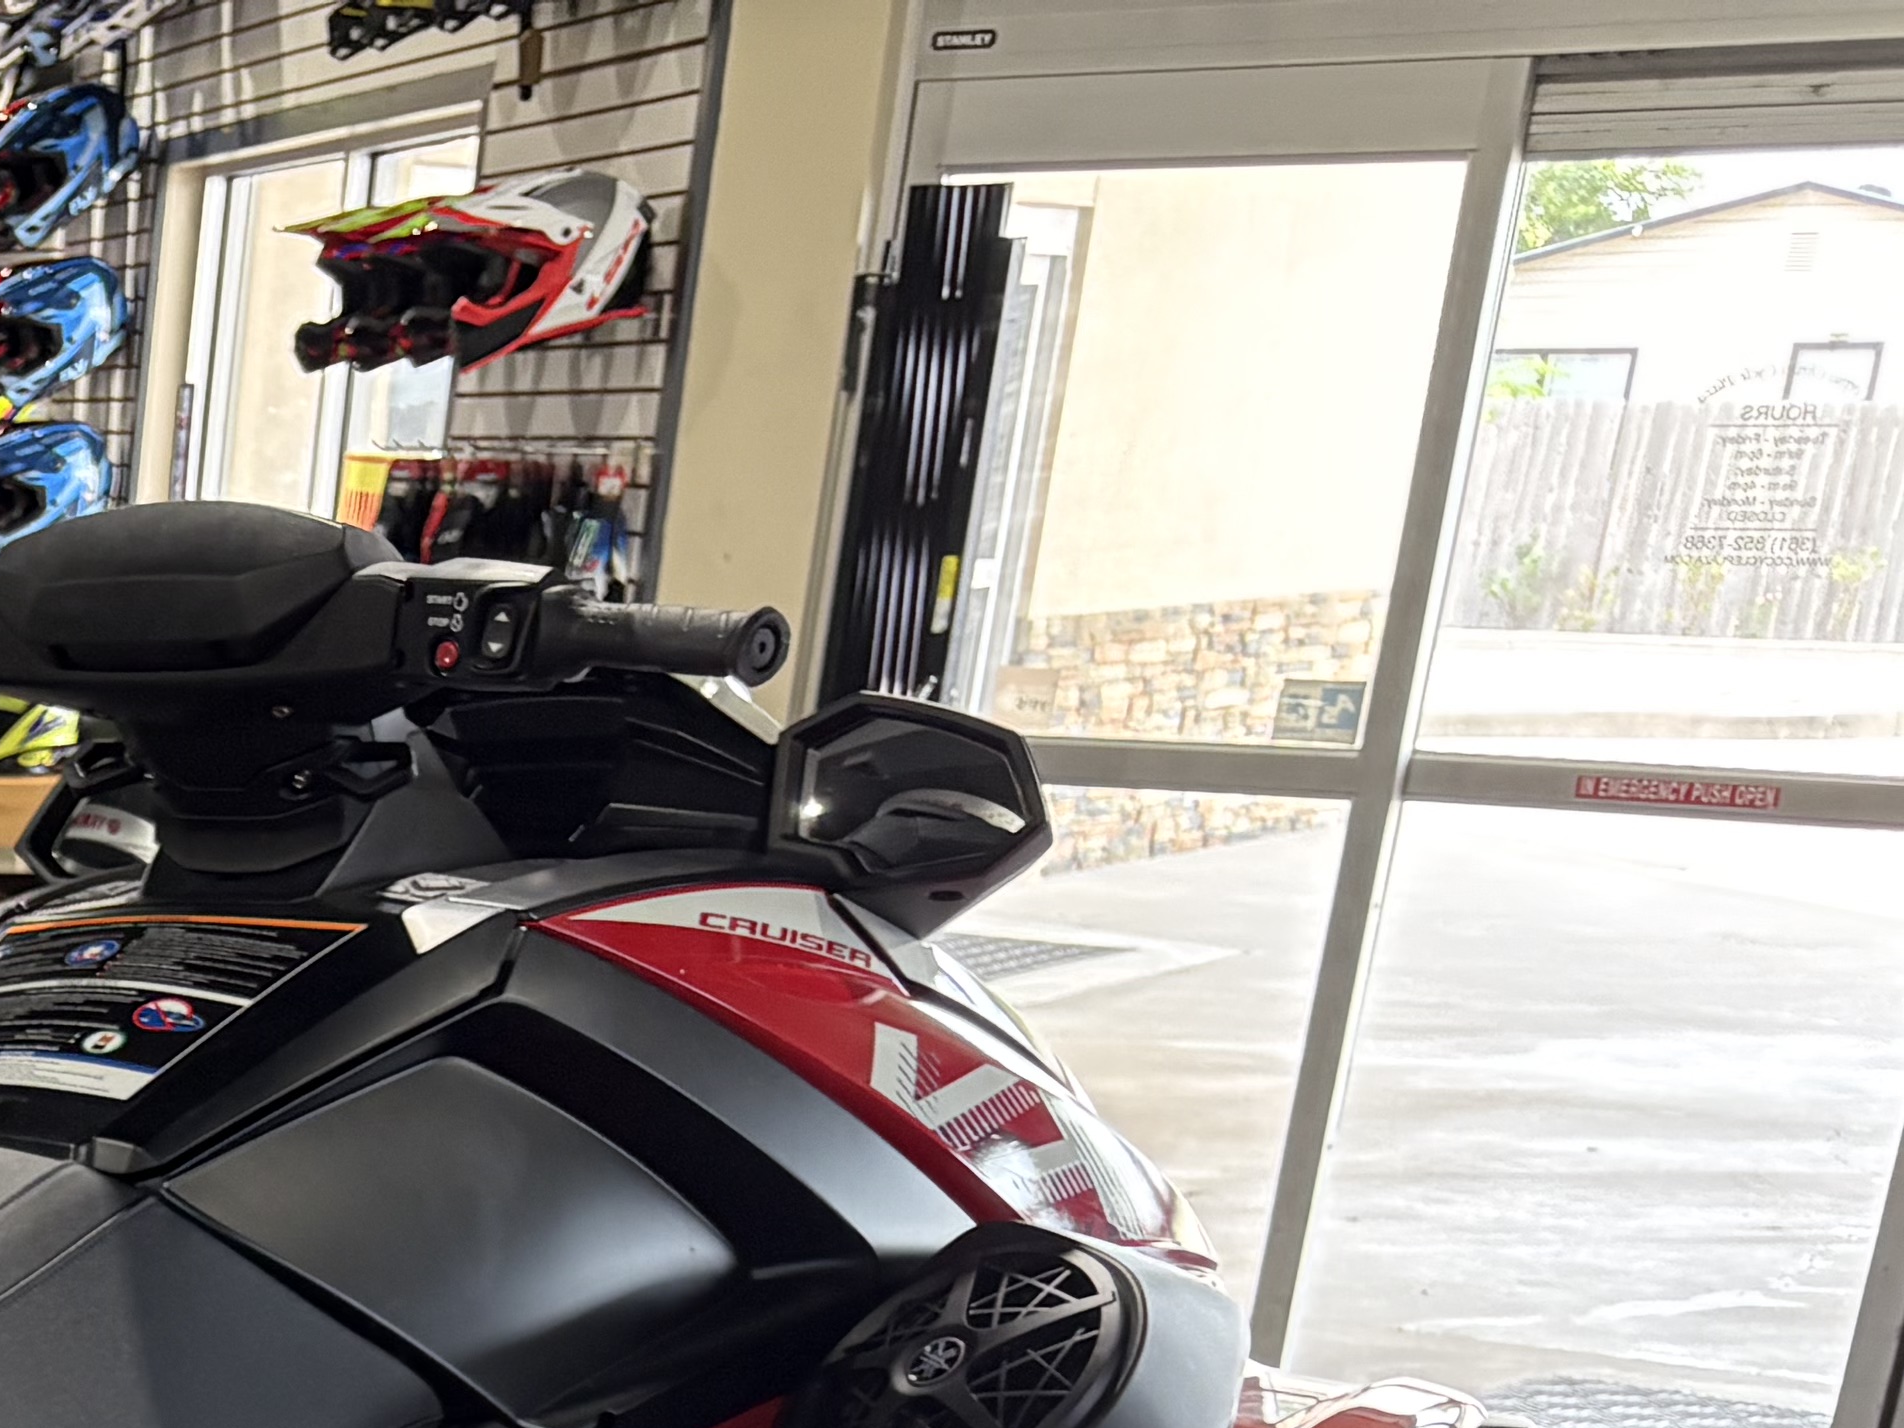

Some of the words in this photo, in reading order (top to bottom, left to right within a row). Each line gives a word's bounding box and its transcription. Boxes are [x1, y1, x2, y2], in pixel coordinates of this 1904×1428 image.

[1599, 778, 1689, 801] EMERGENCY
[1691, 783, 1734, 803] PUSH
[1735, 785, 1778, 808] OPEN
[698, 911, 874, 969] CRUISER
